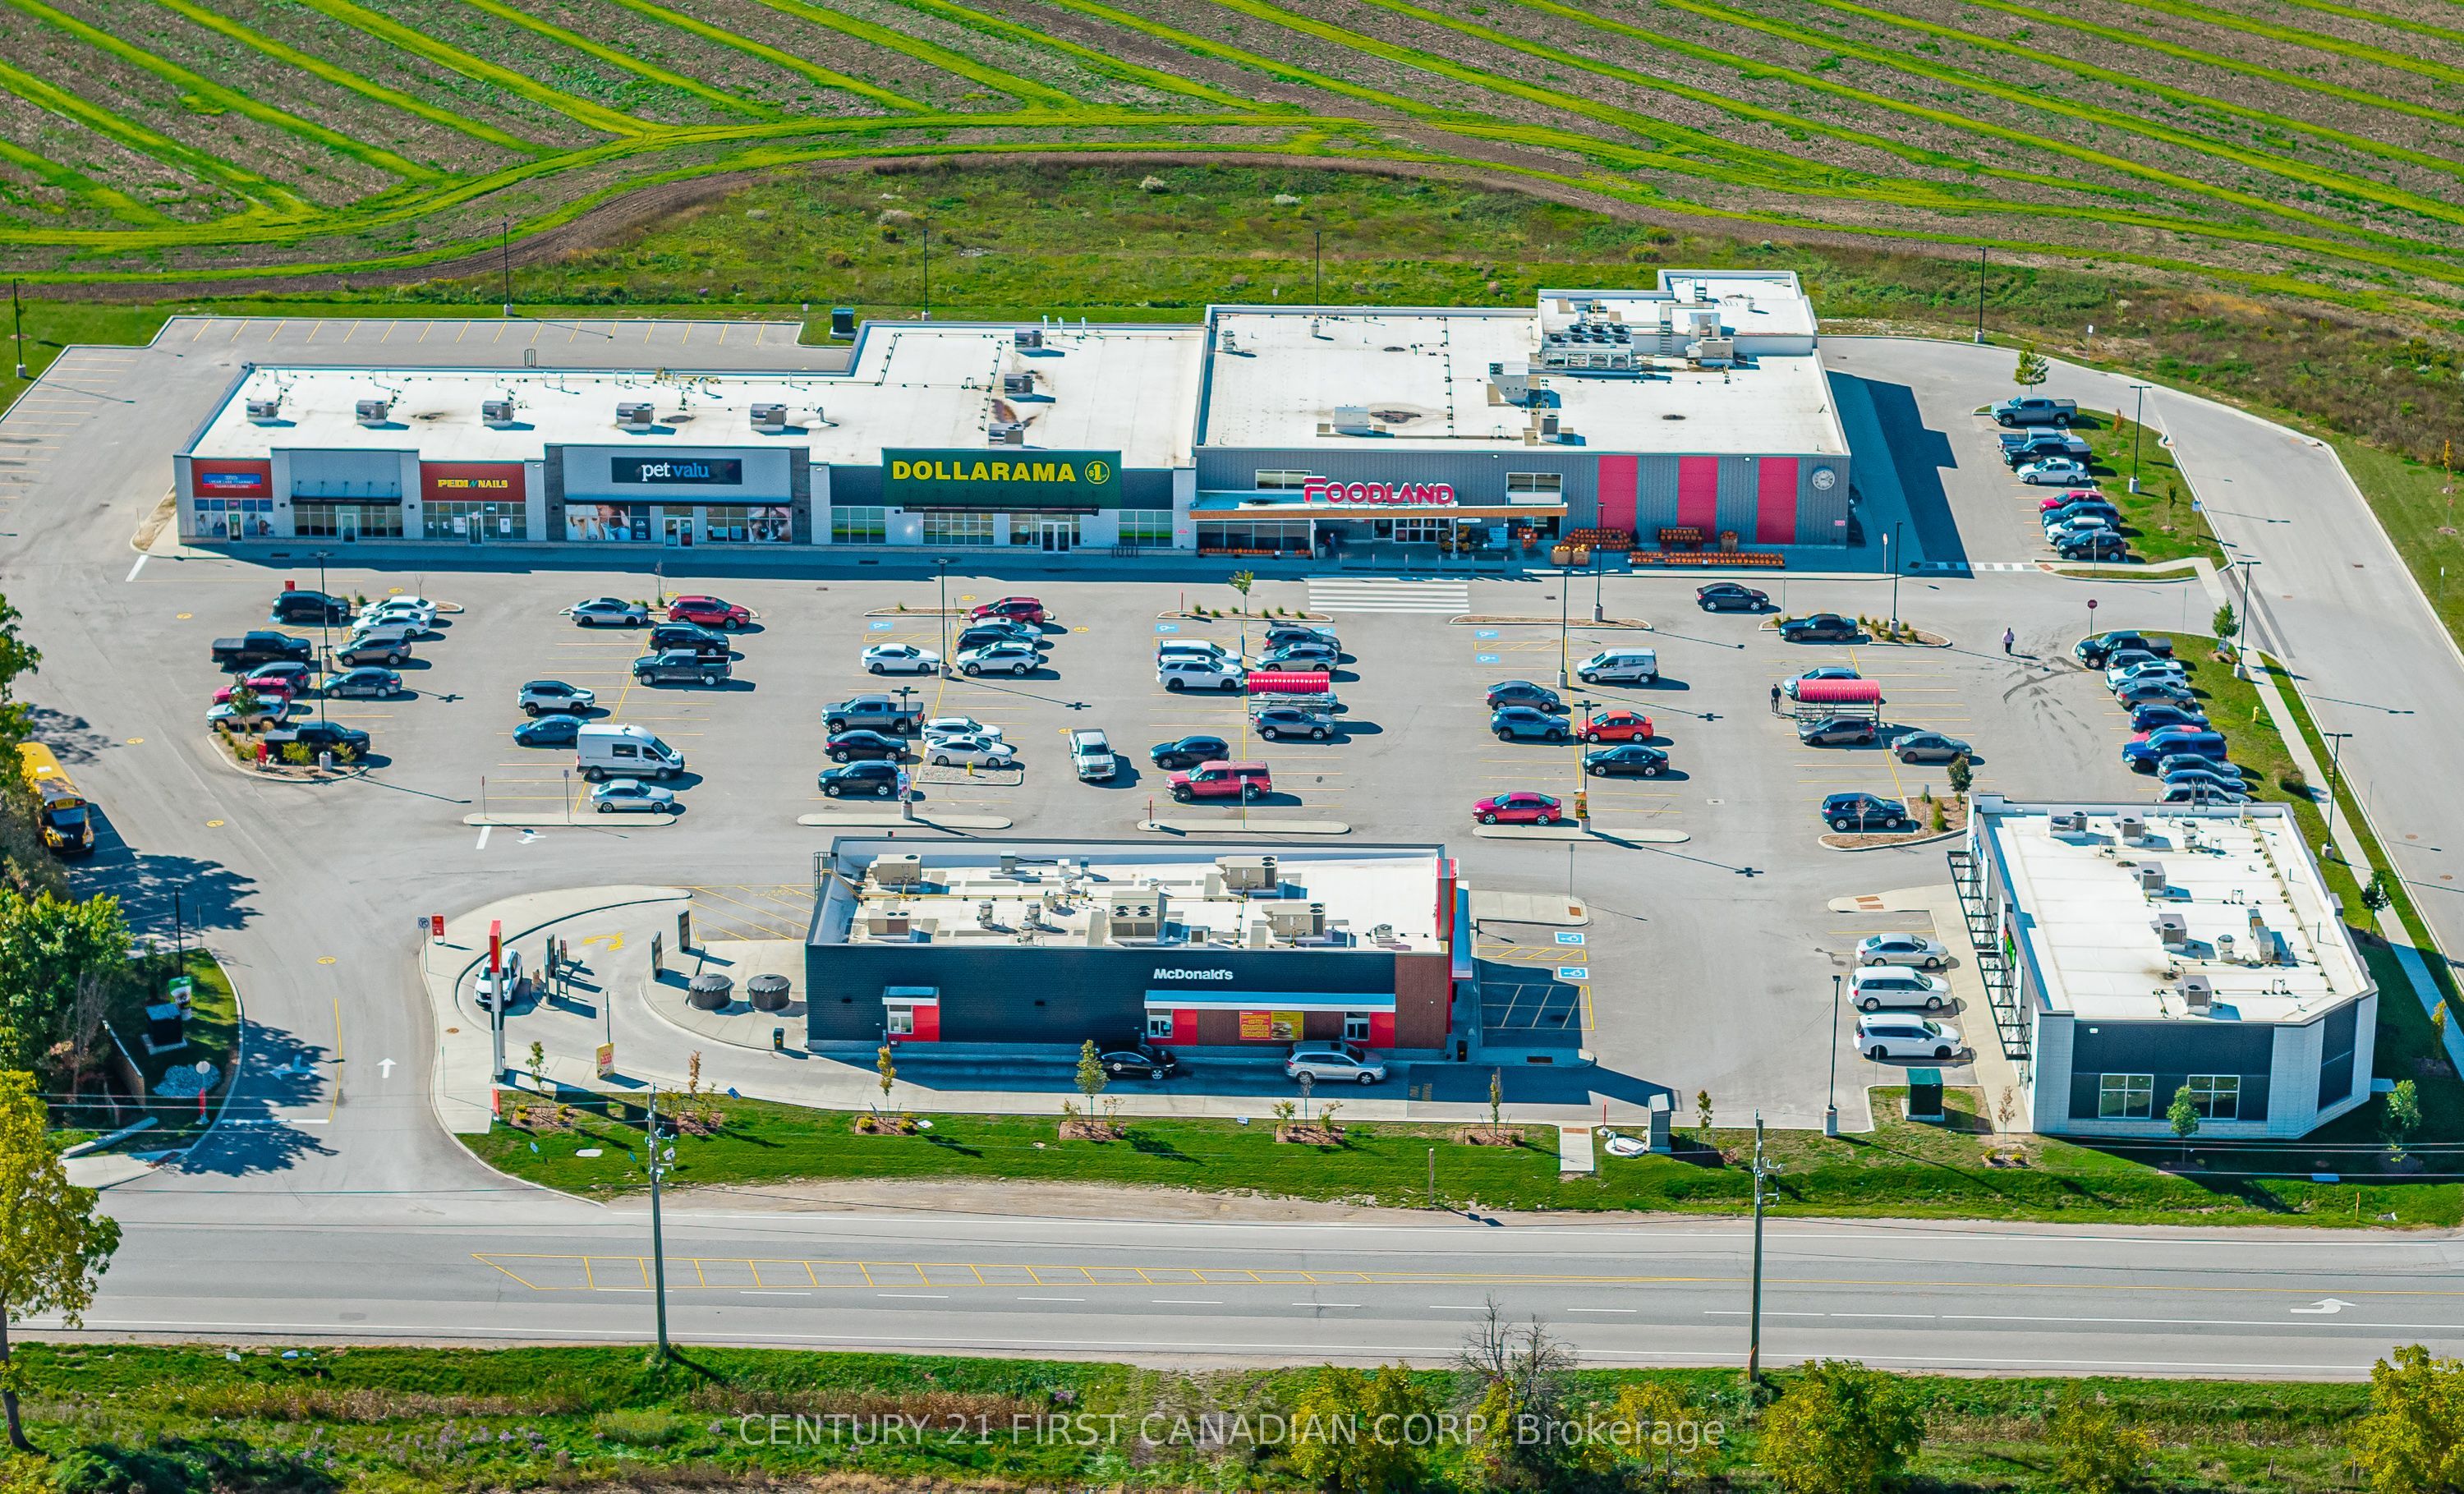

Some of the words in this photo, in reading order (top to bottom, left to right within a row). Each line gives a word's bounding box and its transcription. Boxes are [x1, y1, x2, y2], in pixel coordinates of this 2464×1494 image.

[641, 462, 671, 482] pet
[672, 462, 710, 478] valu
[892, 460, 1077, 482] DOLLARAMA
[438, 479, 469, 489] PEDI
[478, 479, 508, 489] NAILS
[1153, 968, 1234, 981] McDonald's
